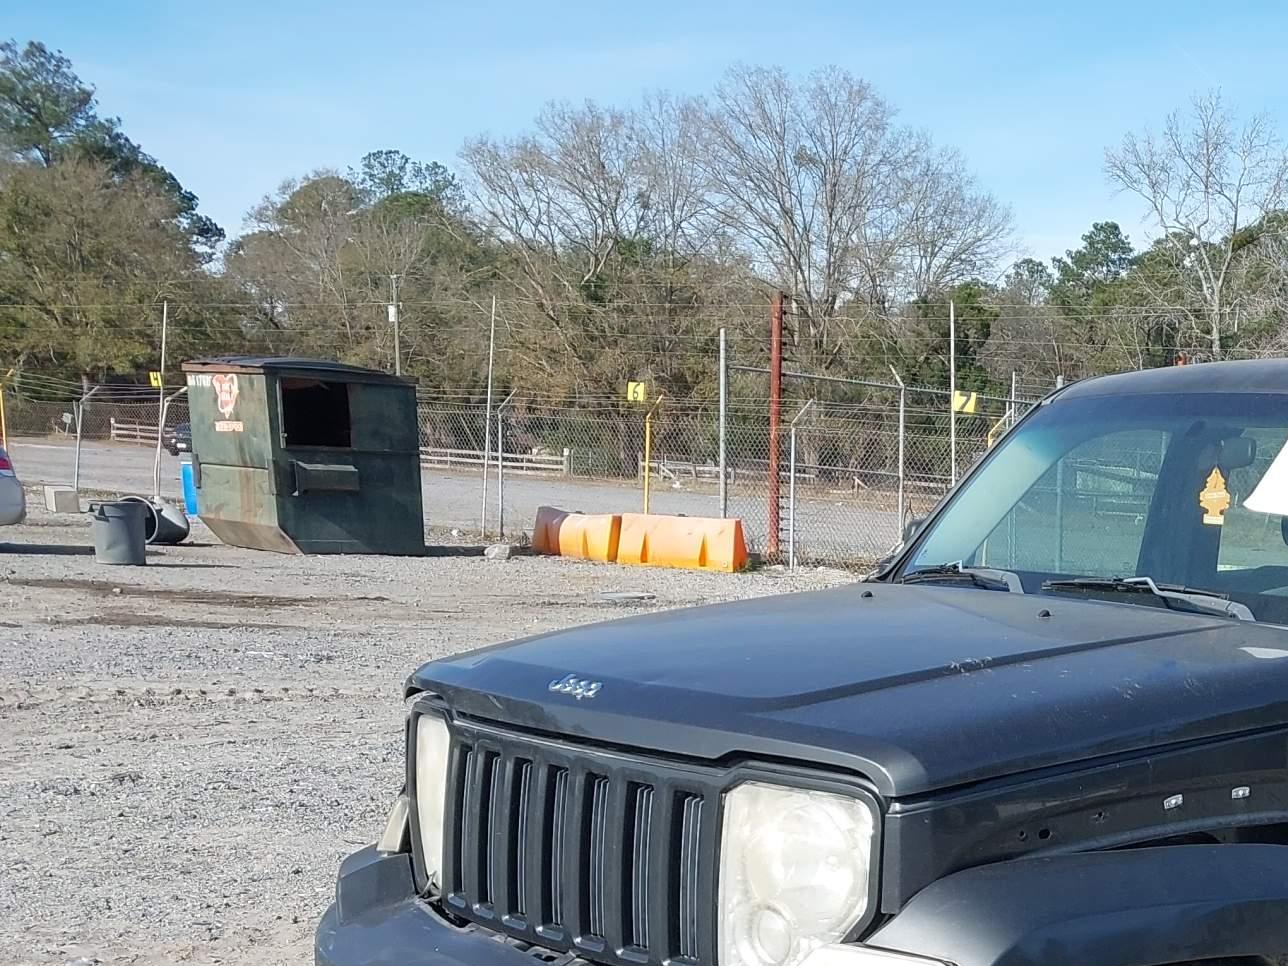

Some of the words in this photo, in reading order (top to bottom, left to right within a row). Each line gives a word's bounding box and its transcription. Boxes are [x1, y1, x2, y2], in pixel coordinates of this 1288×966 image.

[632, 381, 641, 401] 6
[958, 391, 972, 411] 7
[548, 673, 603, 700] Jeep
